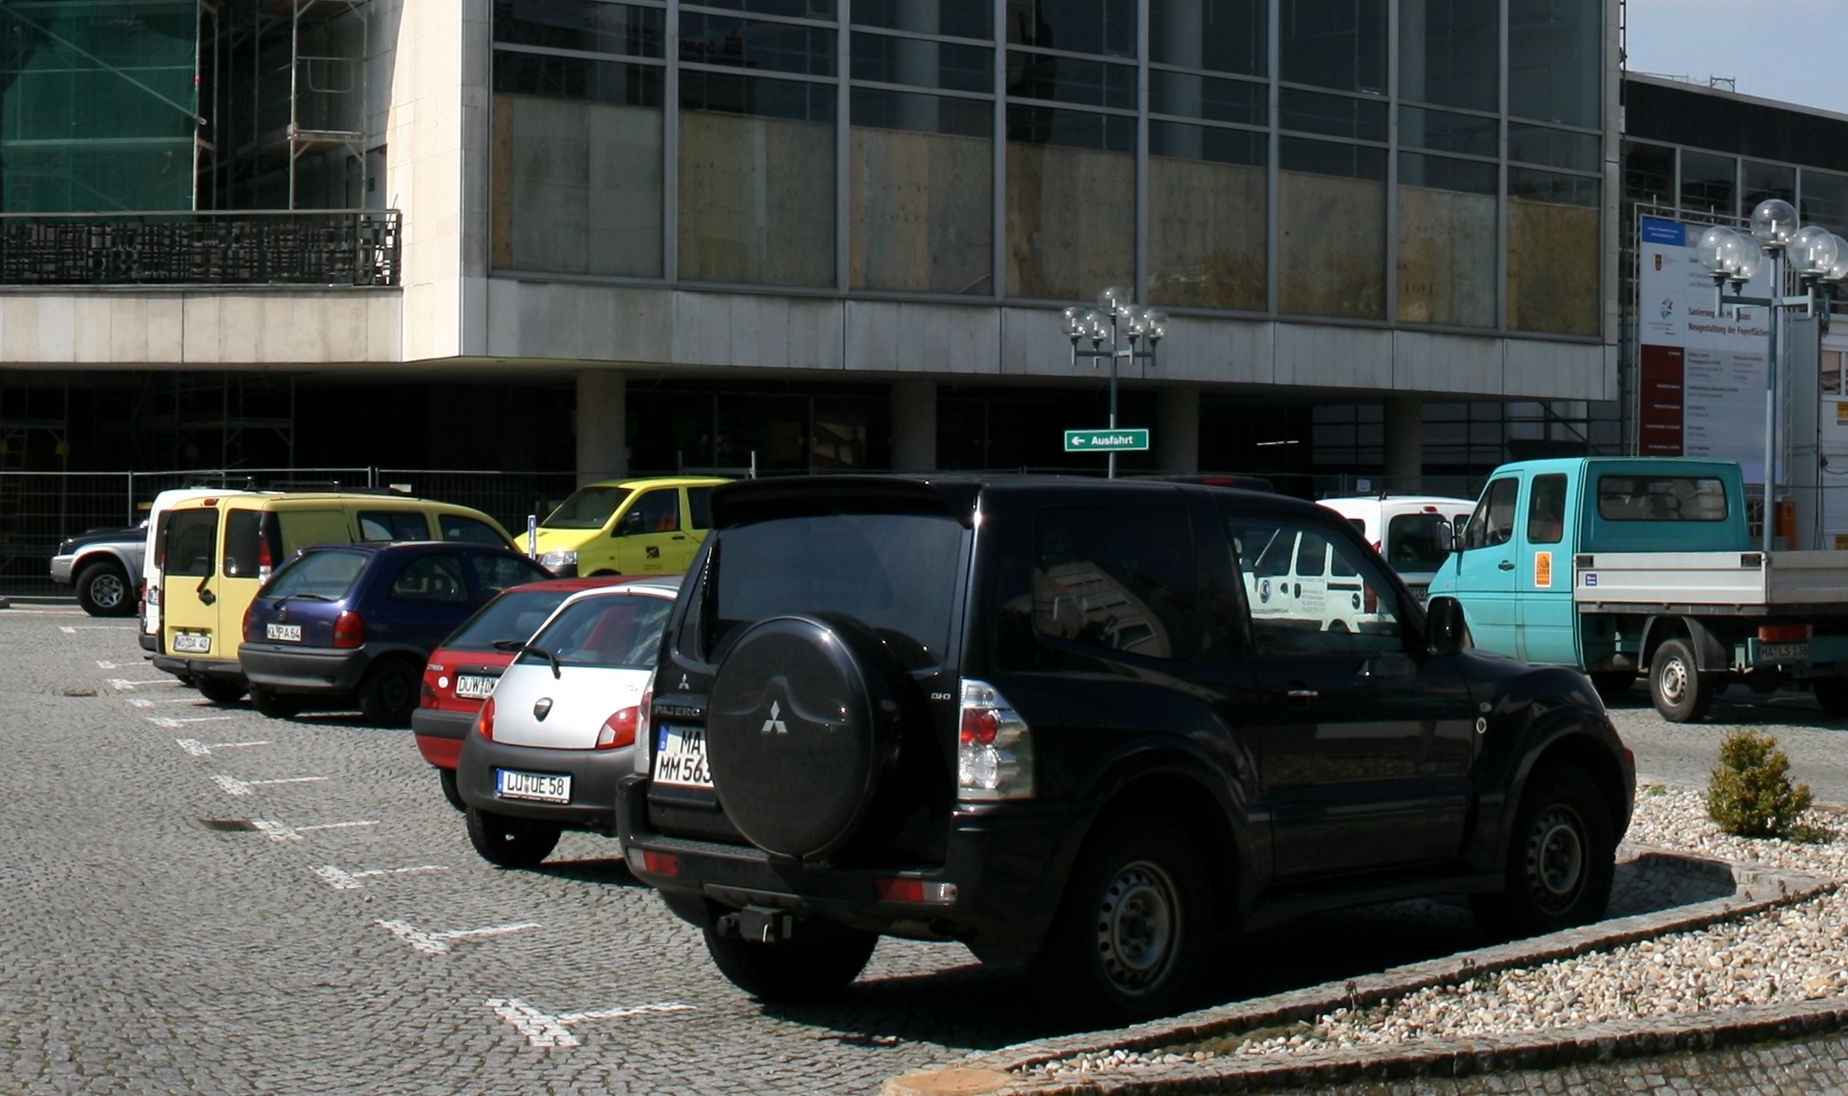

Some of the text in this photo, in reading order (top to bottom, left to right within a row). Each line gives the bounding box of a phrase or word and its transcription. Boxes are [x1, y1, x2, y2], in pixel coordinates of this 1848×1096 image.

[1091, 434, 1134, 445] Ausfahrt
[654, 704, 700, 717] PAJERO
[680, 730, 701, 755] MA
[659, 754, 681, 780] MM
[507, 773, 523, 792] LU
[549, 777, 565, 796] 58
